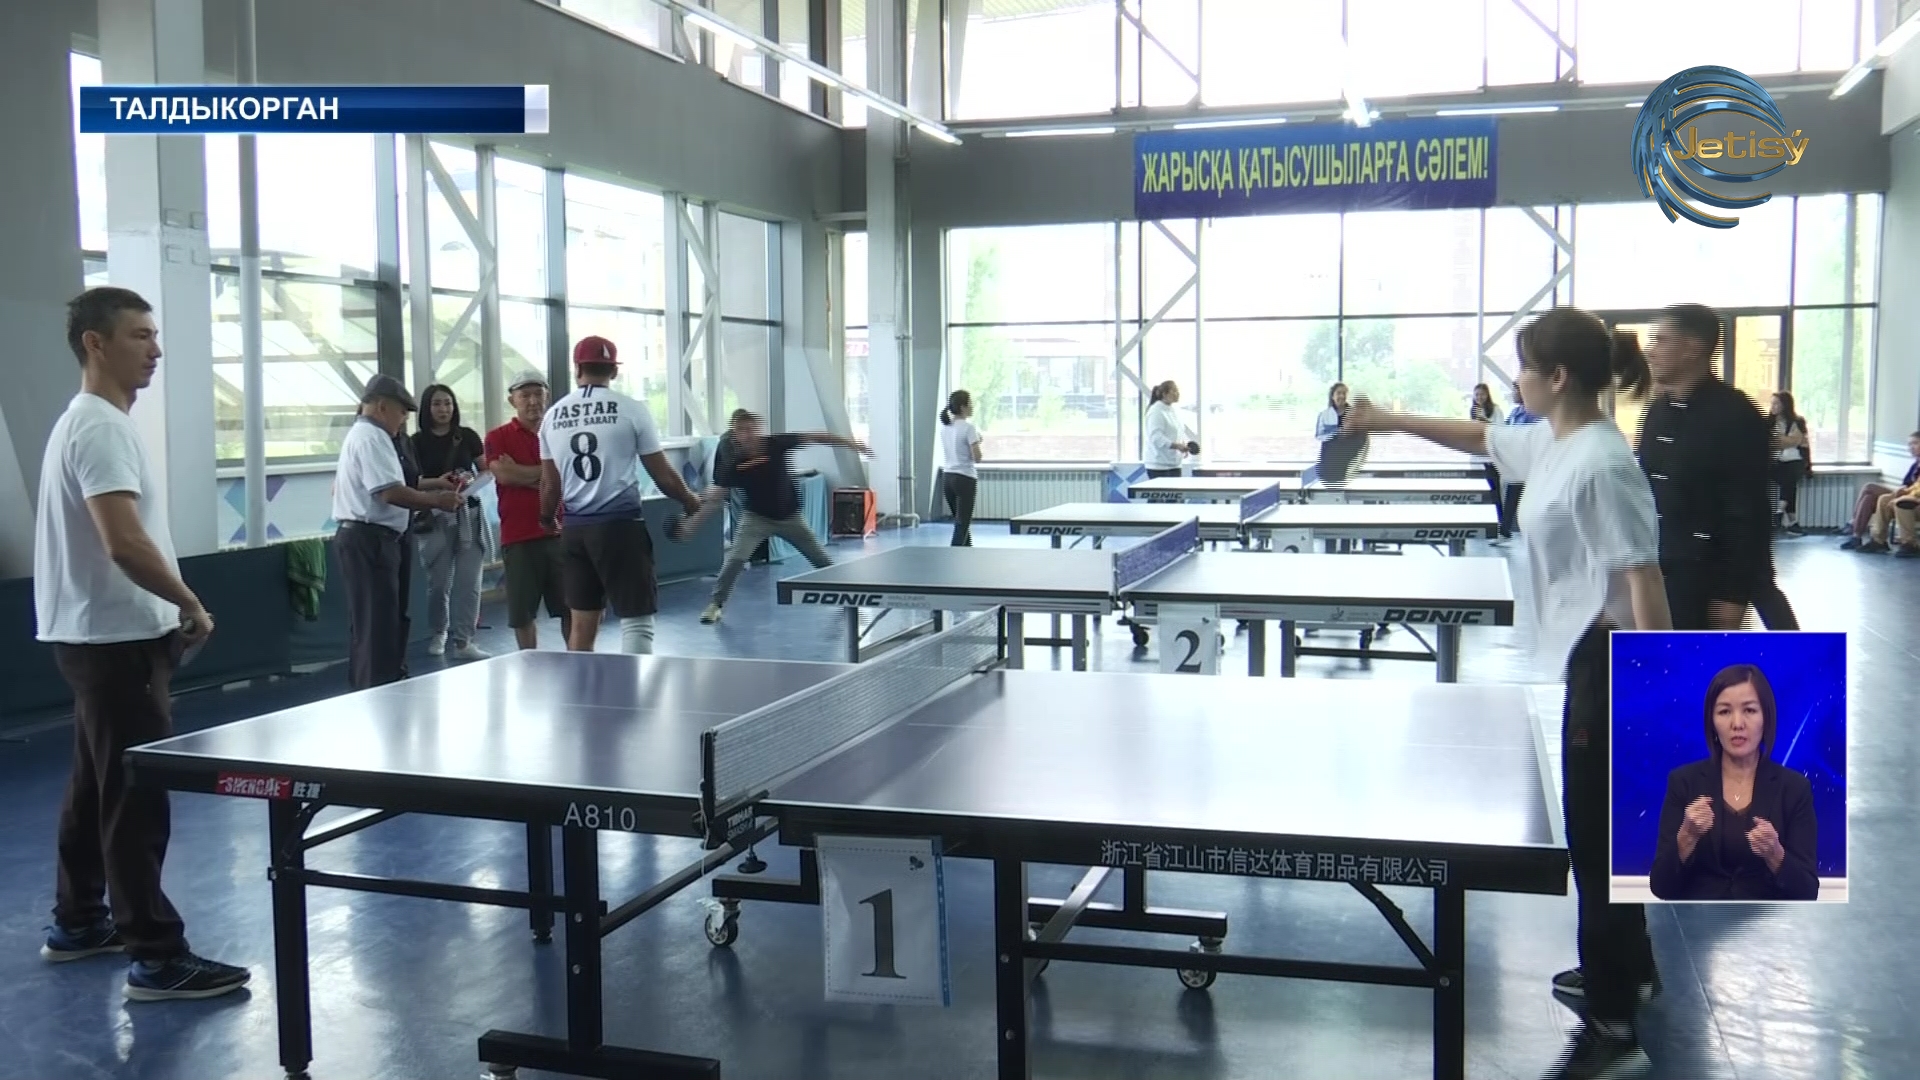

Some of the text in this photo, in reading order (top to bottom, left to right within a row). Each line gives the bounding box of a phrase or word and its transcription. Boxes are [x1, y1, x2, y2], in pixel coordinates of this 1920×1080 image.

[1142, 136, 1489, 198] ЖАРЫСҚА ҚАТЫСУШЫЛАРҒА СӘЛЕМ!
[552, 415, 618, 430] SPORT SARAIY
[570, 431, 602, 482] 8
[1027, 526, 1084, 535] DONIC
[1414, 529, 1479, 538] DONIC
[802, 591, 883, 606] DONIC
[1383, 608, 1483, 623] DONIC
[1174, 629, 1203, 673] 2
[563, 801, 637, 831] A810
[1101, 839, 1449, 886] 浙江省江山市信达体育用品有限公司
[858, 888, 907, 980] 1
